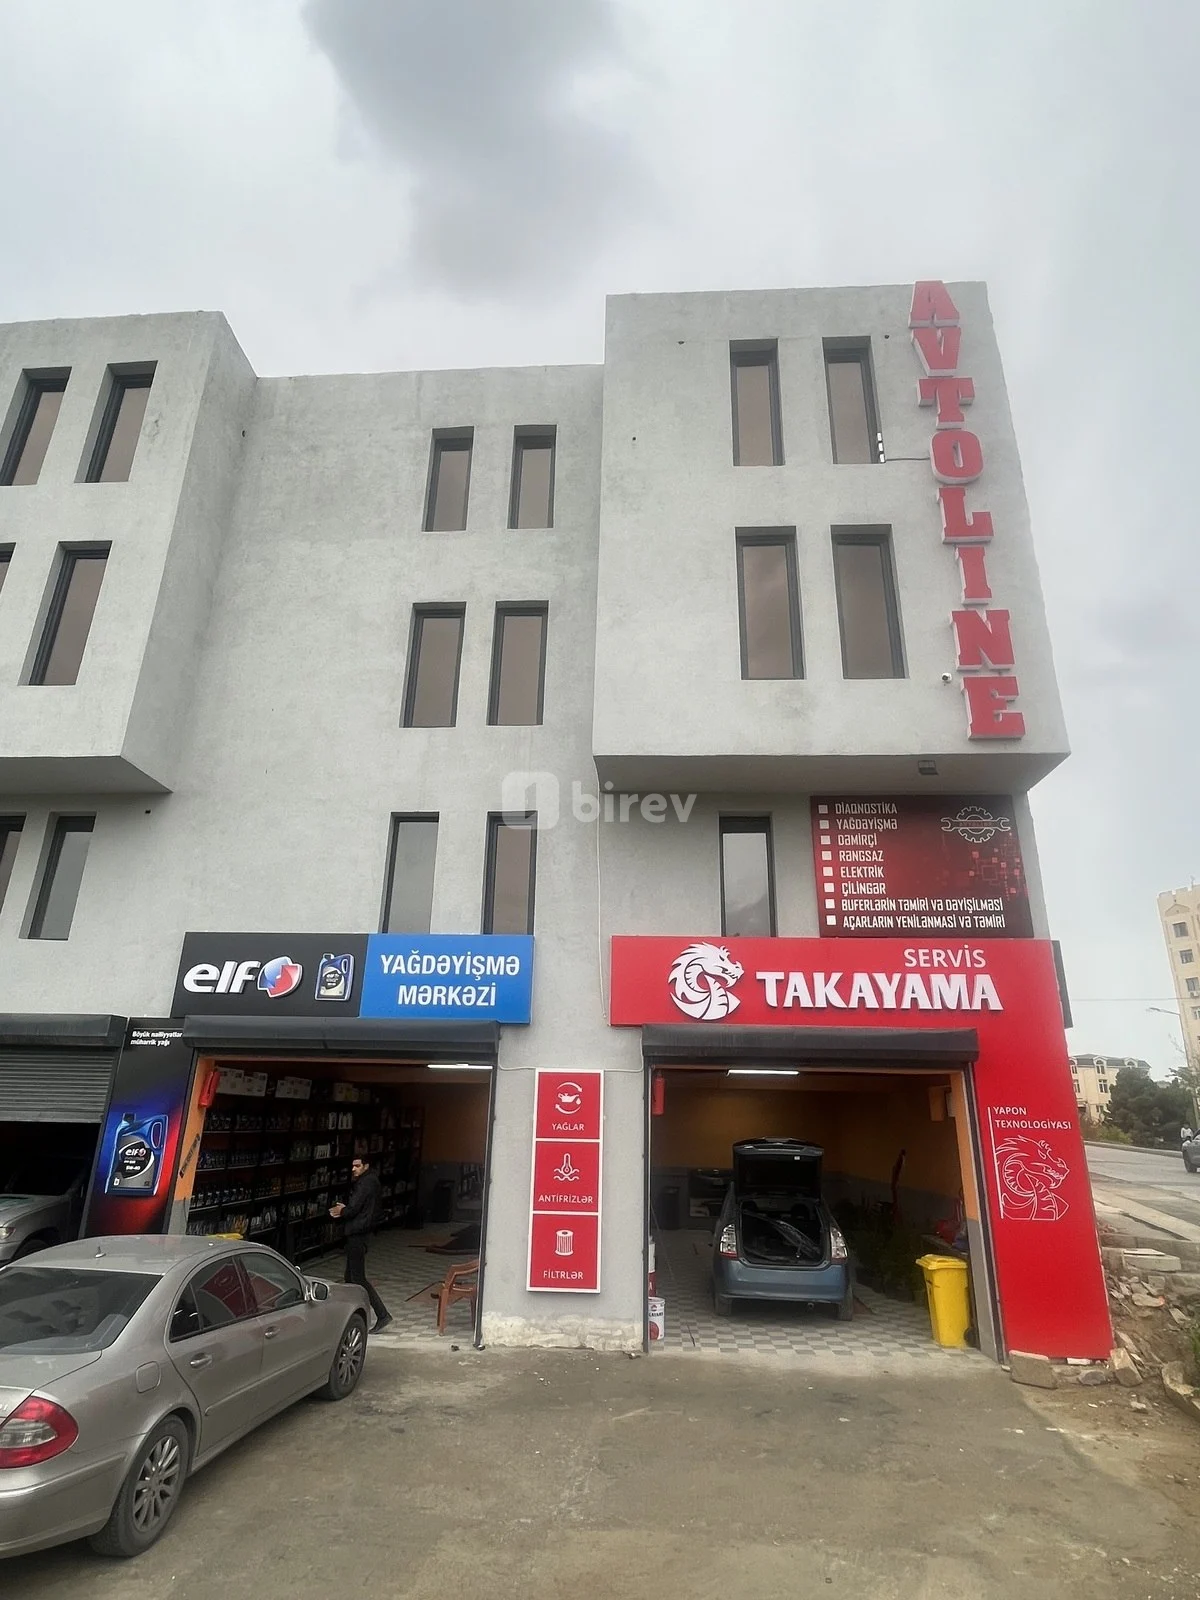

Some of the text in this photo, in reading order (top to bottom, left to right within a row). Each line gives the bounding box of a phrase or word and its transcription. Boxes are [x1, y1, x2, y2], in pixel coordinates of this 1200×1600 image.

[908, 280, 1026, 740] AVTOLINE
[840, 864, 884, 878] ELEKTRİK
[843, 915, 894, 931] AÇARLARIN
[903, 944, 987, 968] SERVİS
[183, 957, 263, 995] elf
[755, 971, 1004, 1011] TAKAYAMA
[993, 1106, 1027, 1115] YAPON
[552, 1122, 585, 1131] YAĞLAR
[994, 1119, 1071, 1129] TEXNOLOGİYASI
